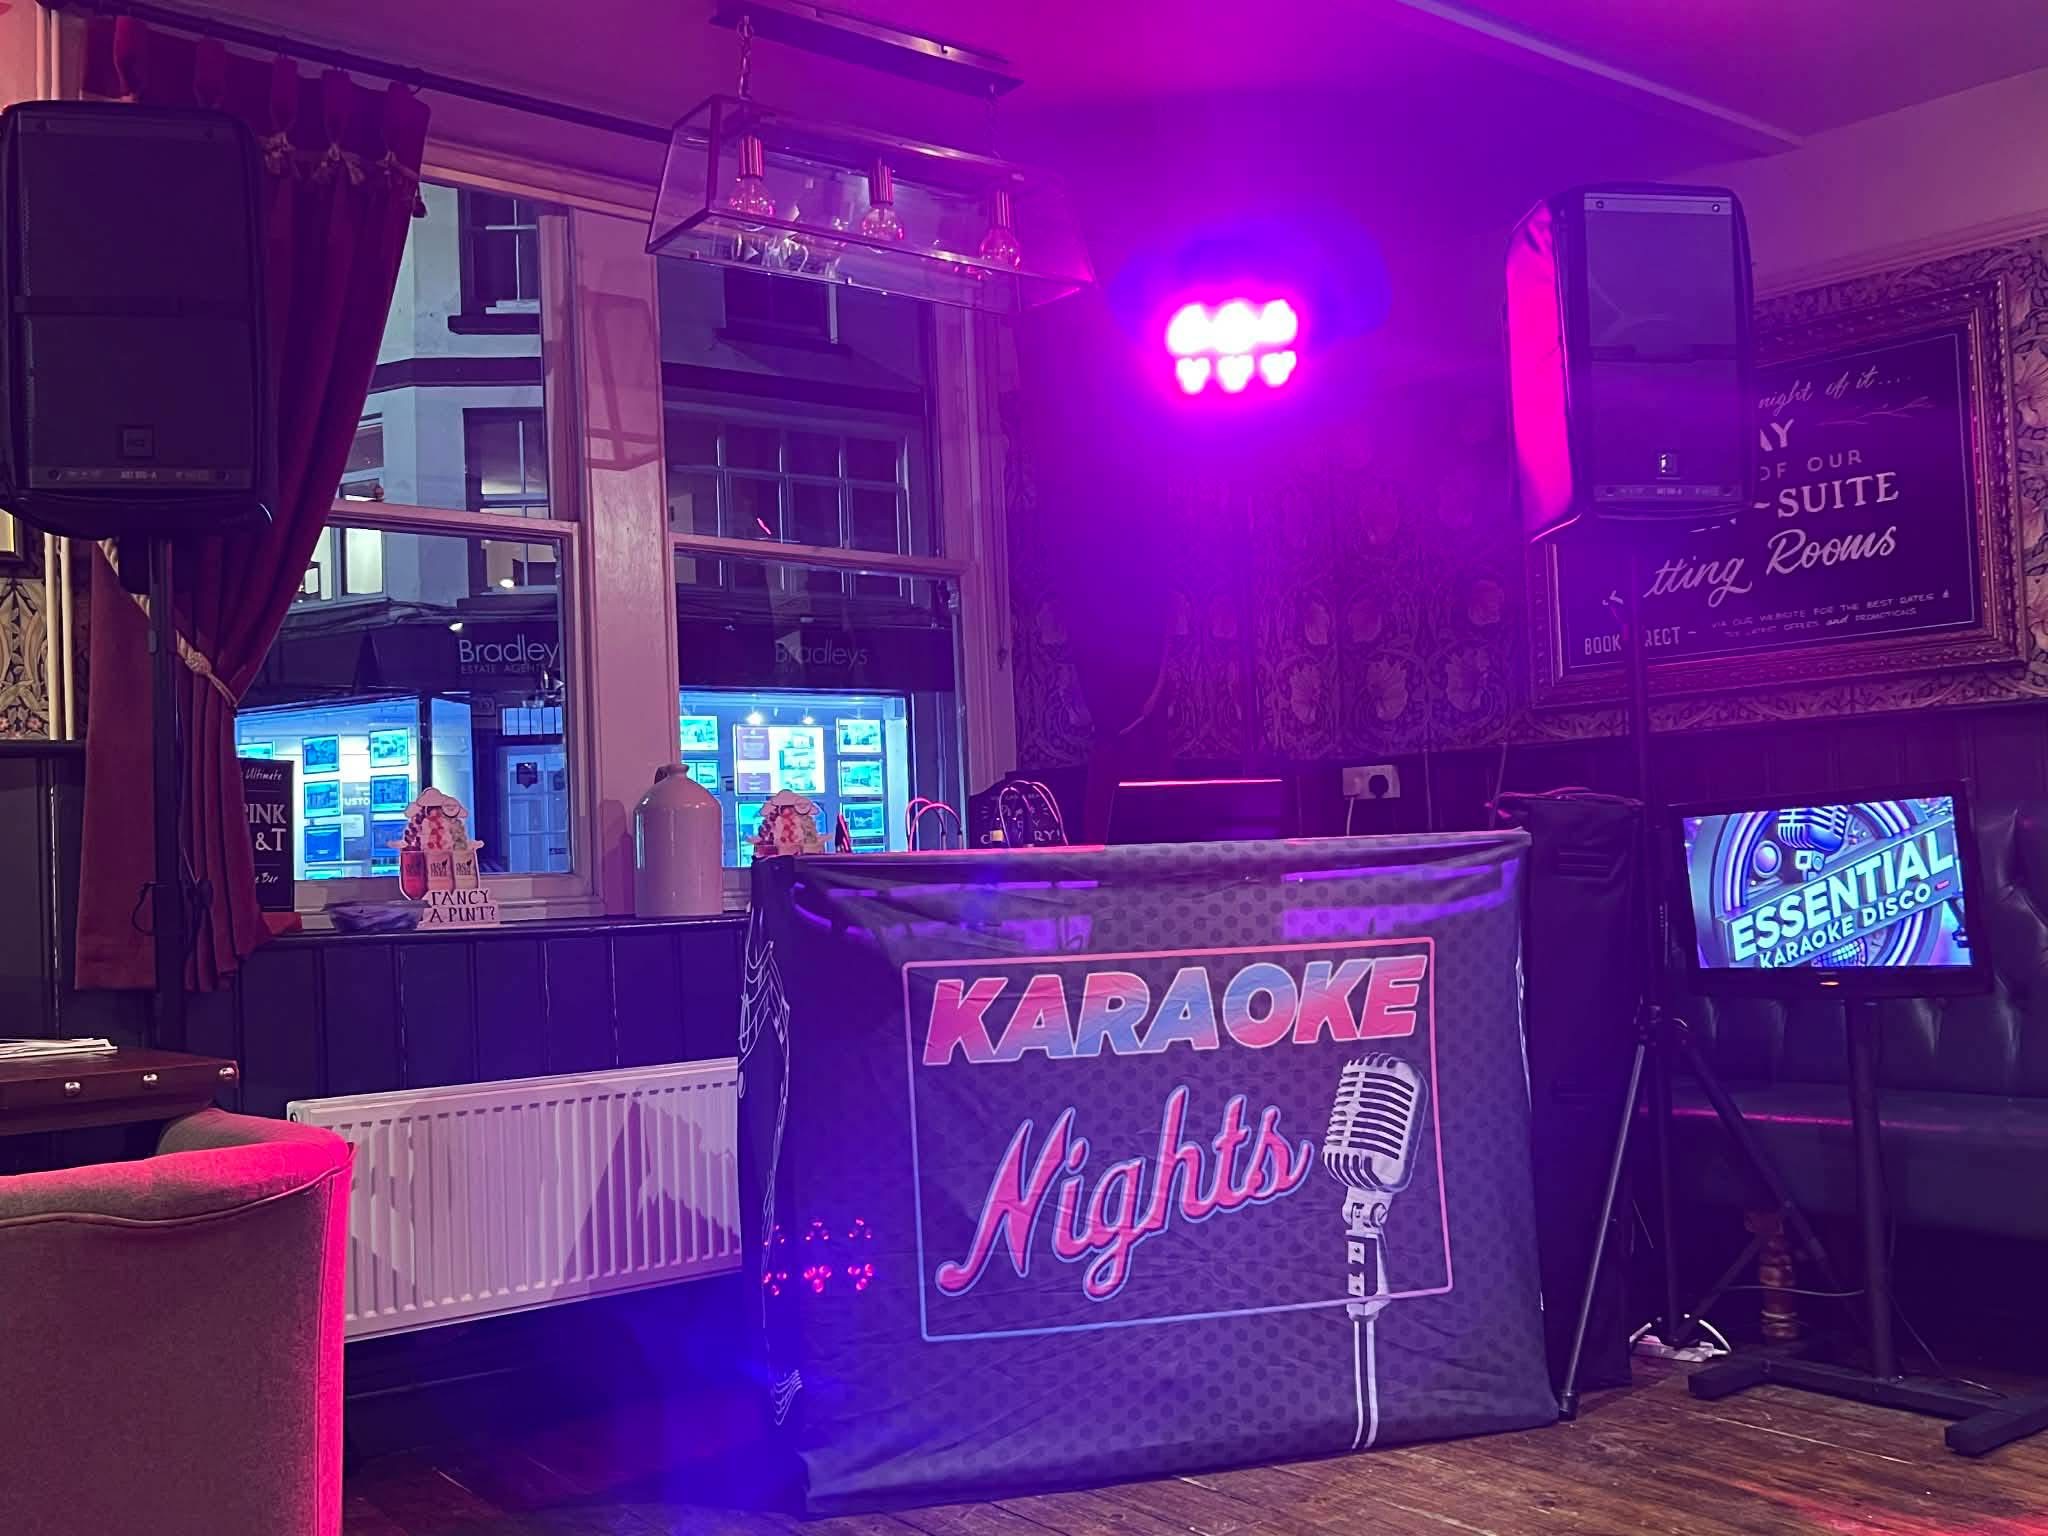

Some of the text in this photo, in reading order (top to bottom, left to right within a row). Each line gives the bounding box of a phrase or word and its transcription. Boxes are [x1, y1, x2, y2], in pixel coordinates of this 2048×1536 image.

[1824, 371, 1851, 399] of
[1807, 449, 1862, 472] OUR
[1753, 471, 1900, 519] -SUITE
[1640, 526, 1897, 607] tting Rooms
[1865, 597, 1895, 610] BEST
[458, 632, 560, 669] Bradley
[775, 638, 868, 673] Bradleys
[1583, 633, 1622, 657] BOOK
[1641, 625, 1680, 649] RECT
[243, 803, 288, 824] INK
[254, 827, 288, 852] &T
[431, 889, 489, 906] FANCY
[1730, 830, 1954, 962] ESSENTIAL
[430, 906, 495, 923] A PINT?
[1758, 882, 1932, 969] KARAOKE DISCO
[922, 955, 1428, 1066] KARAOKE
[935, 1084, 1315, 1303] Nights
